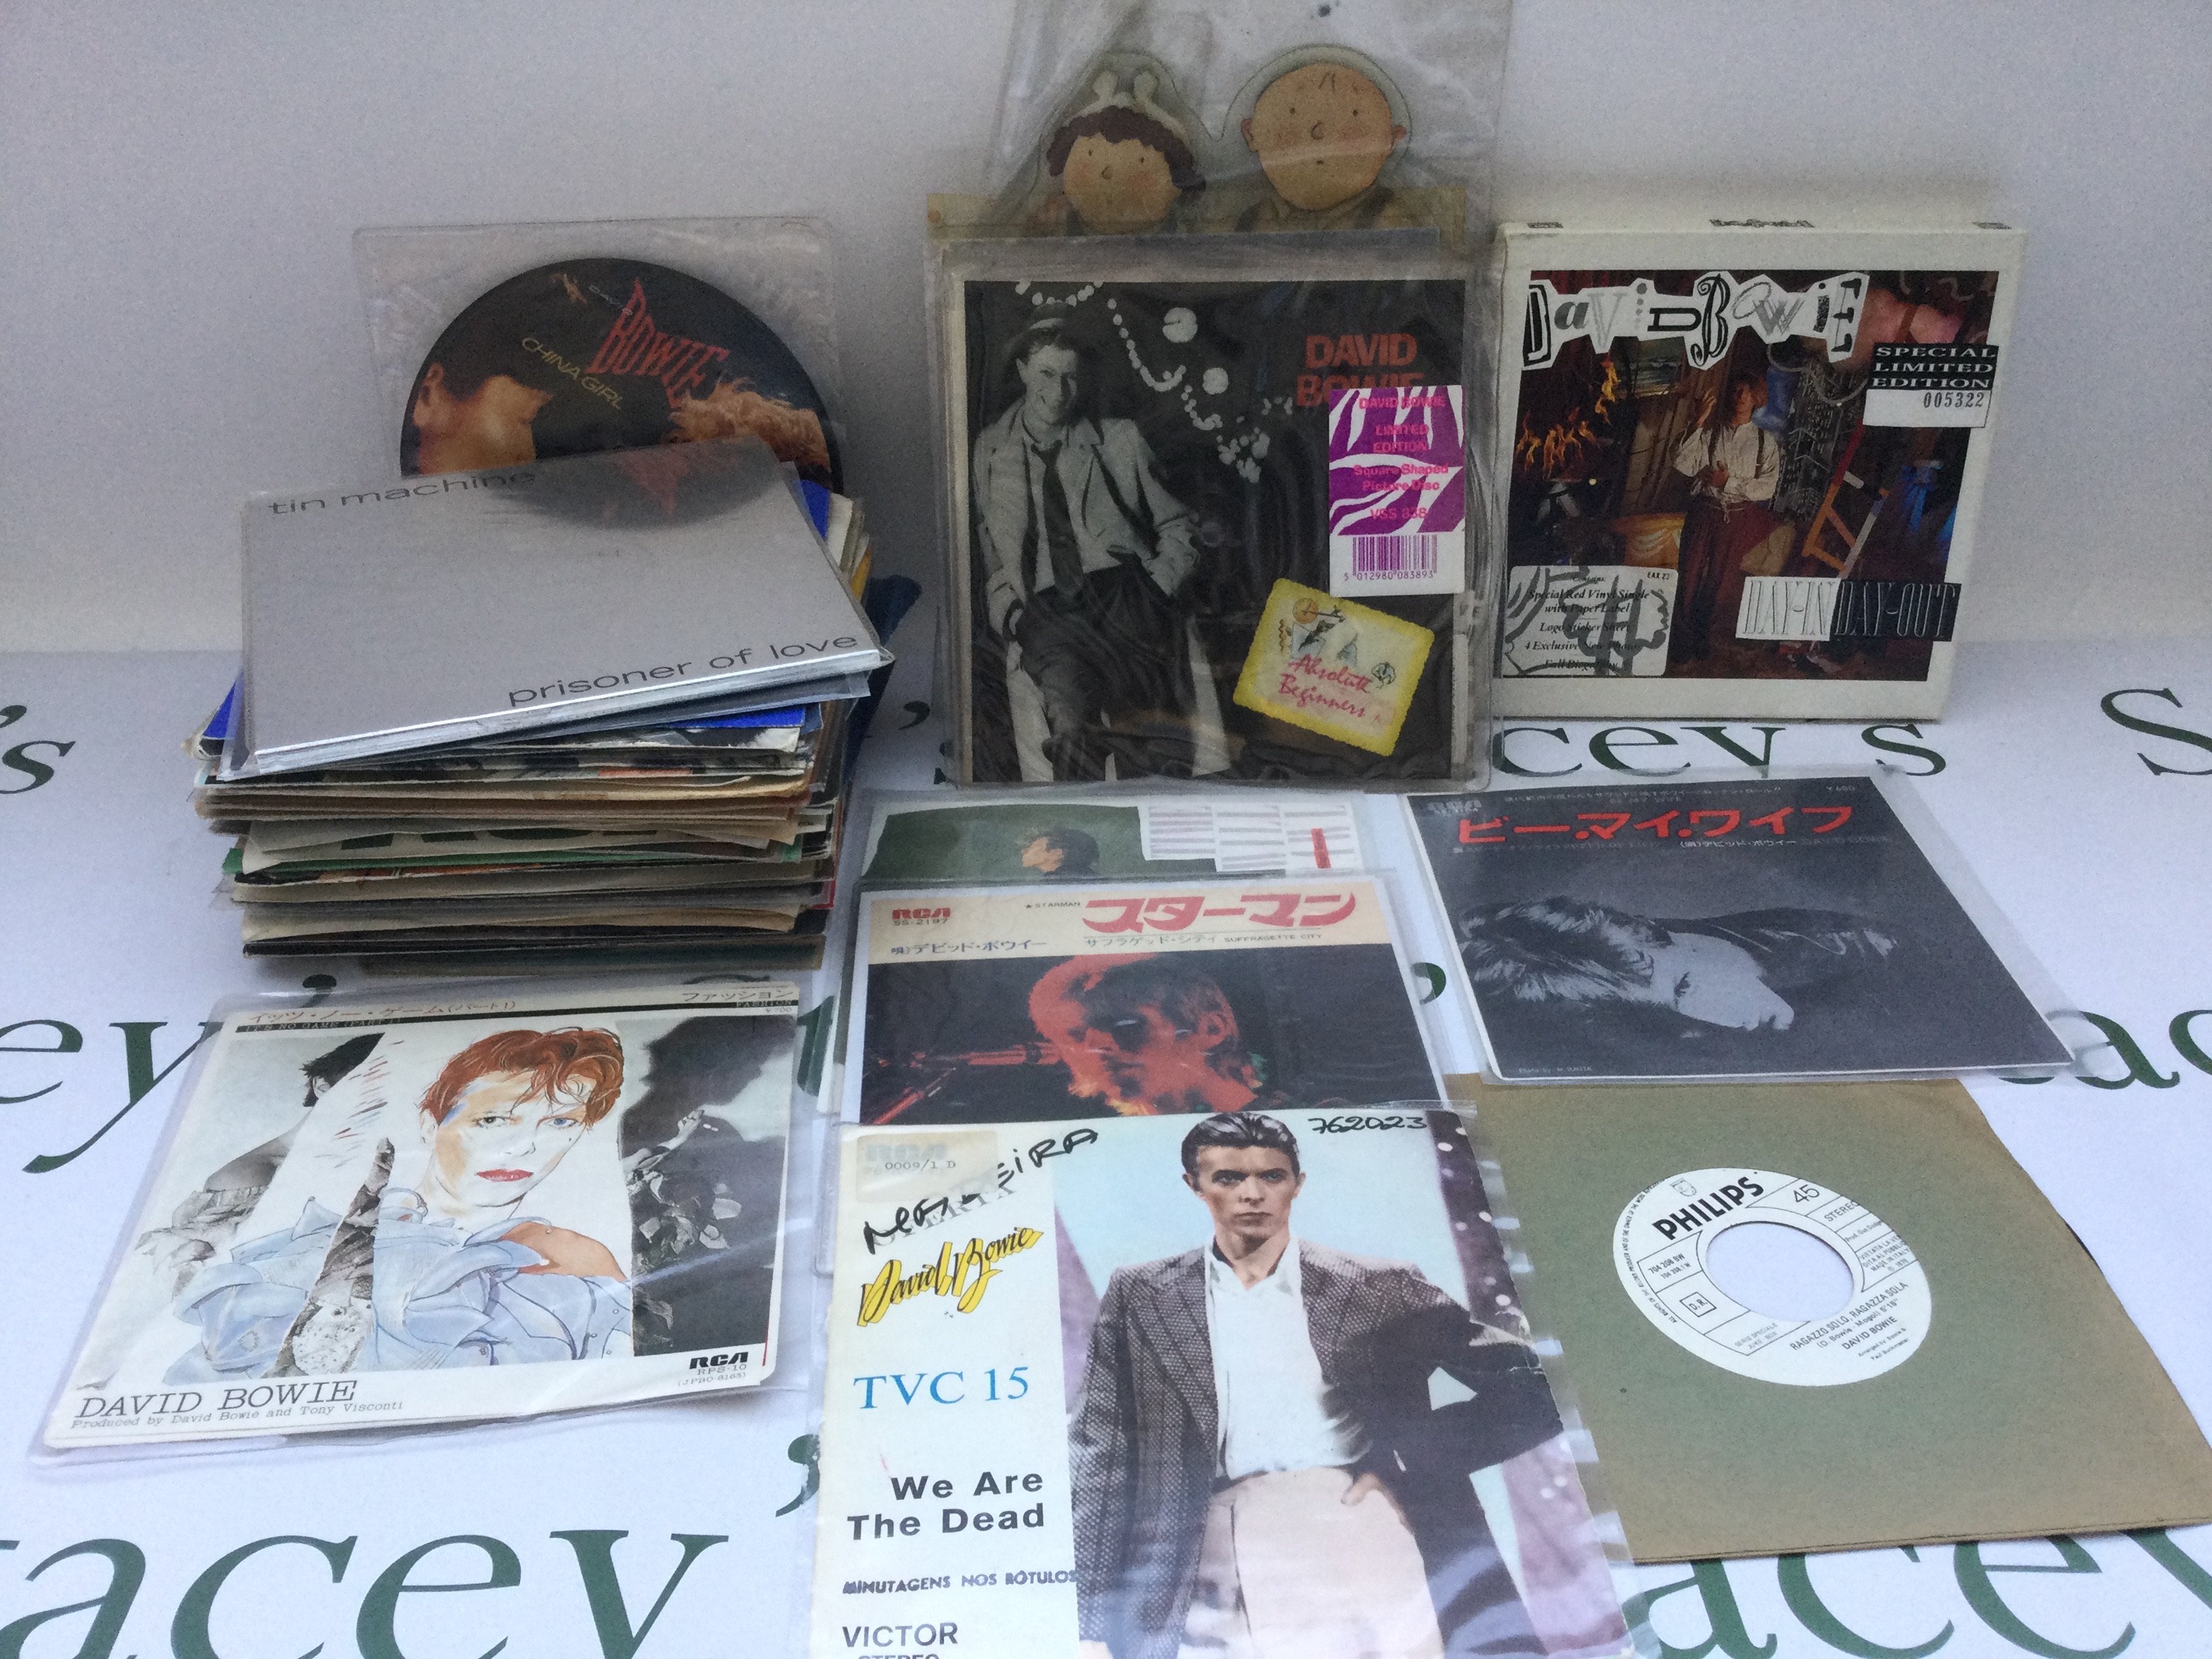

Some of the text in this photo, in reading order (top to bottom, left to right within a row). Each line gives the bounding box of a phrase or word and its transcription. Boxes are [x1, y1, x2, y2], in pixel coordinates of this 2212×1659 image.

[1305, 333, 1417, 369] DAVID
[1876, 346, 1996, 357] SPECIAL
[522, 337, 625, 410] CHINA GIRL
[1873, 362, 1993, 372] LIMITED
[1871, 377, 1990, 388] EDITION
[1358, 396, 1398, 409] DAVID
[1923, 392, 1985, 408] 005322
[1401, 463, 1449, 476] Shaped
[268, 474, 536, 514] tin machine
[1412, 478, 1440, 491] Disc
[1370, 508, 1397, 520] VSS
[508, 634, 857, 707] prisoner of love
[1278, 673, 1366, 718] Beginners
[891, 907, 951, 920] RCA
[1082, 892, 1355, 934] スターマン
[947, 1160, 956, 1169] D
[1793, 1184, 1820, 1203] 45
[1650, 1175, 1764, 1241] PHILIPS
[1824, 1200, 1860, 1222] STEREO
[1870, 1260, 1887, 1272] MADE
[1893, 1248, 1910, 1260] ITALY
[1688, 1298, 1708, 1311] D.R.
[1789, 1327, 1829, 1351] RAGAZZO
[1849, 1293, 1888, 1318] RAGAZZA
[1885, 1282, 1908, 1297] SOLA
[1841, 1315, 1898, 1350] DAVID BOWIE
[689, 1351, 749, 1370] RCA
[75, 1380, 358, 1418] DAVID BOWIE
[853, 1366, 1029, 1410] TVC 15
[70, 1401, 404, 1430] Produced by David Bowie and Tony Visconti
[890, 1471, 1043, 1500] We Are
[847, 1502, 1044, 1540] The Dead
[842, 1576, 951, 1595] MINUTAGENS
[962, 1573, 998, 1587] NOS
[842, 1622, 959, 1647] VICTOR
